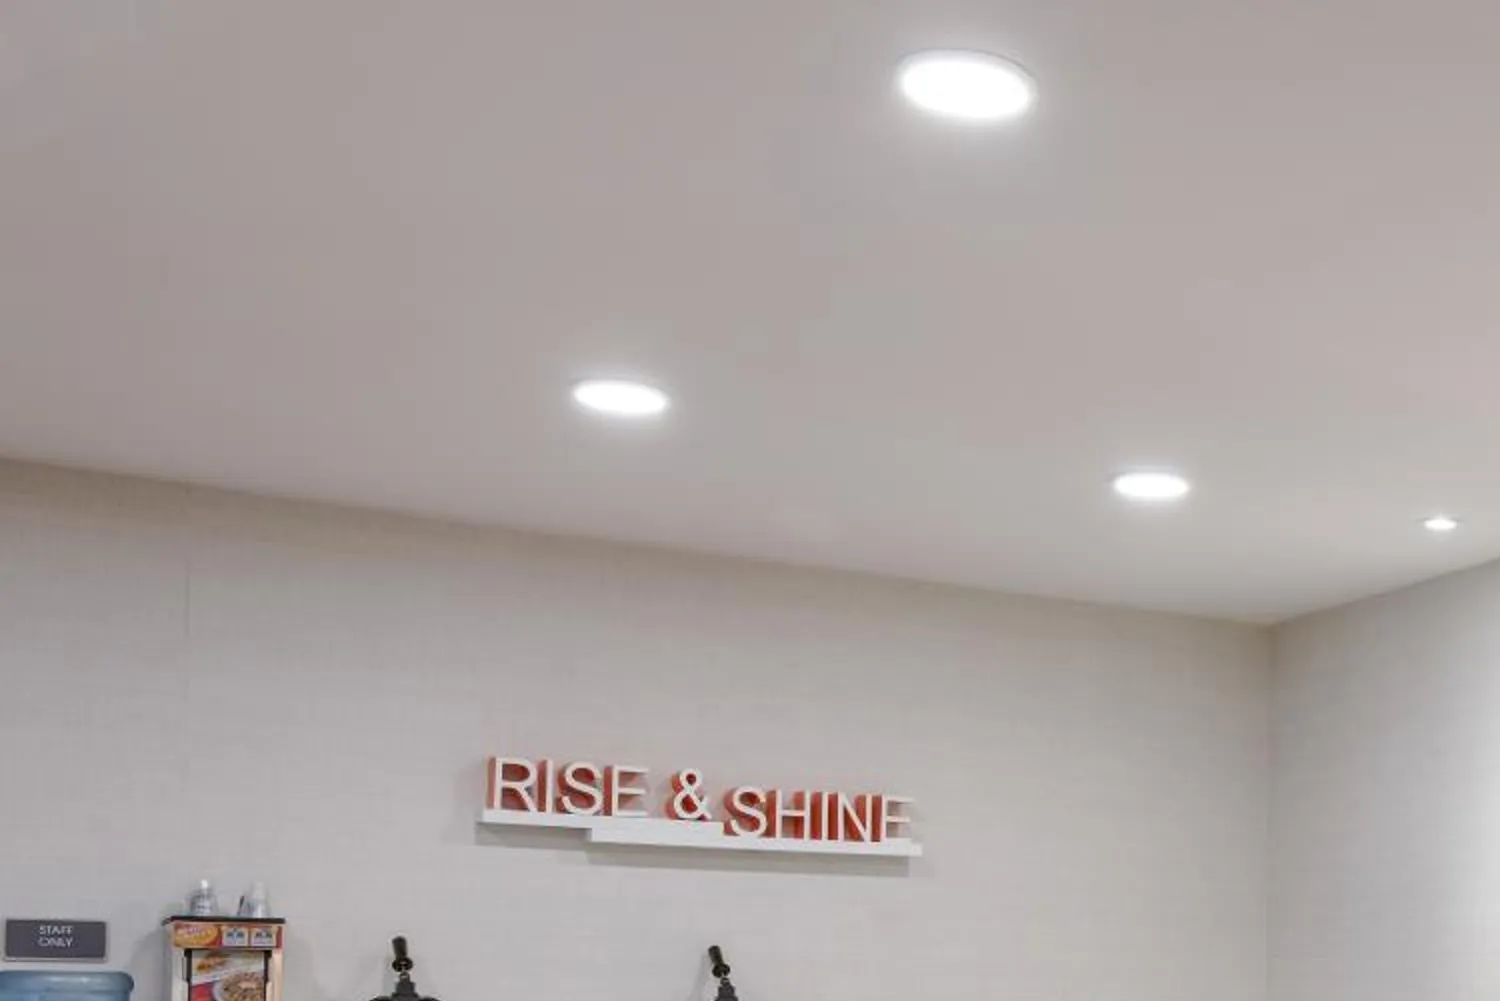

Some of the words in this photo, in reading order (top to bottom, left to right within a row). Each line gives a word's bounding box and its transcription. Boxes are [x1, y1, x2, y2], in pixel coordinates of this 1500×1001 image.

[487, 755, 650, 818] RISE
[667, 766, 712, 823] &
[724, 785, 915, 843] SHINE
[39, 924, 74, 936] STAFF
[38, 936, 74, 949] ONLY
